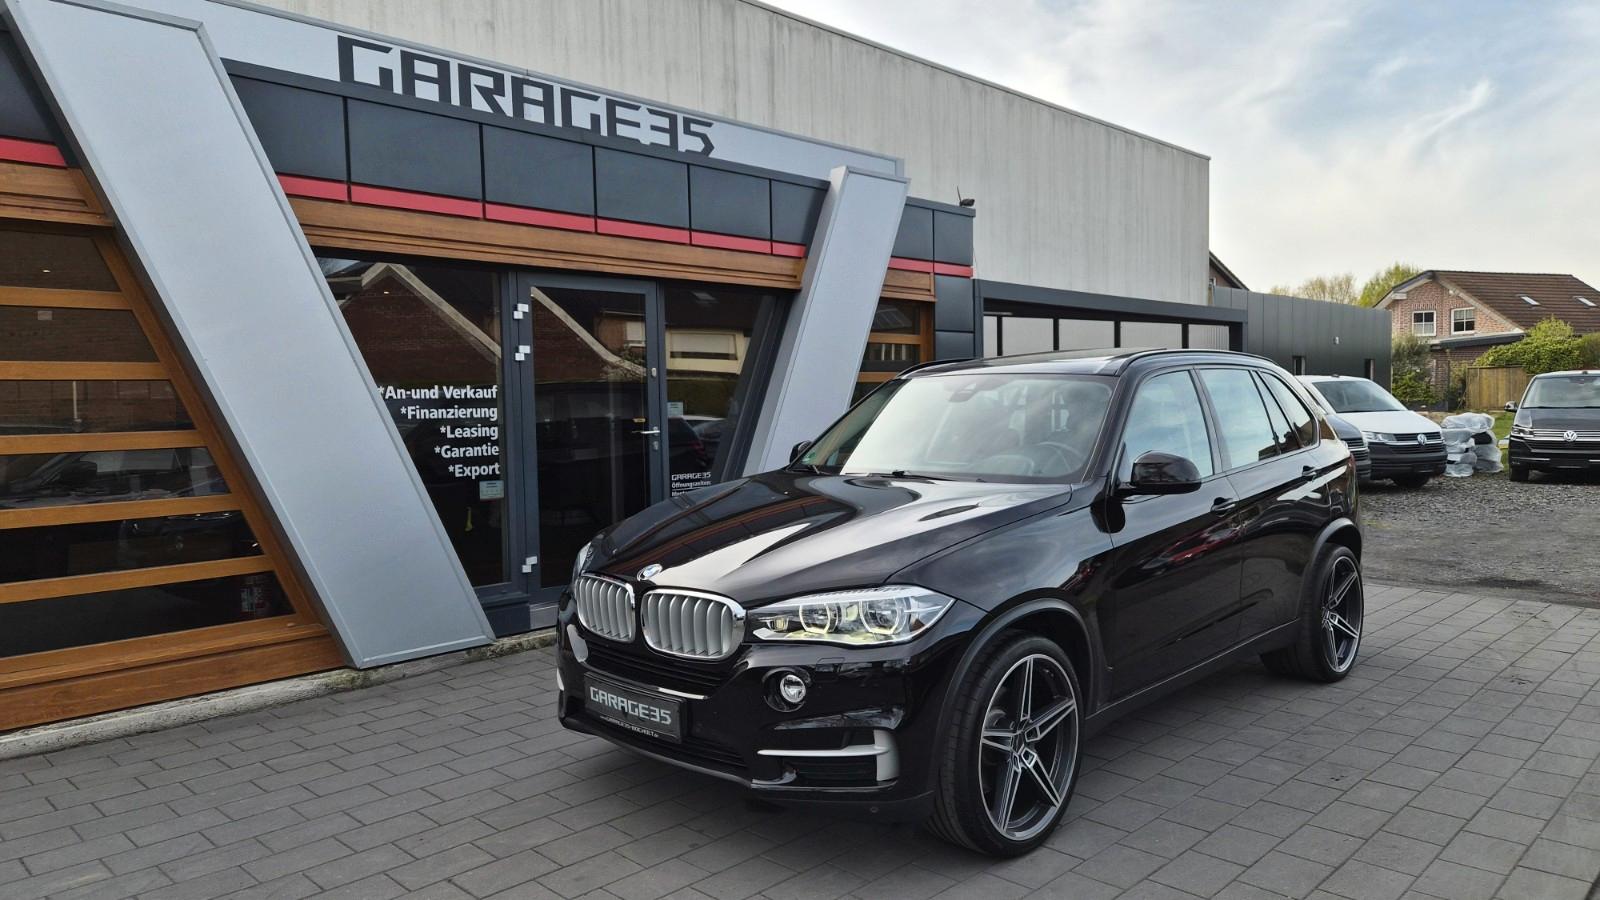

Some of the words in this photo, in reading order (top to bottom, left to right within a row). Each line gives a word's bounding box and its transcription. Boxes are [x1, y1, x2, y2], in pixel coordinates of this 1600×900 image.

[337, 35, 715, 157] GARAGE35
[443, 385, 498, 399] Verkauf
[590, 687, 671, 725] GARAGE35
